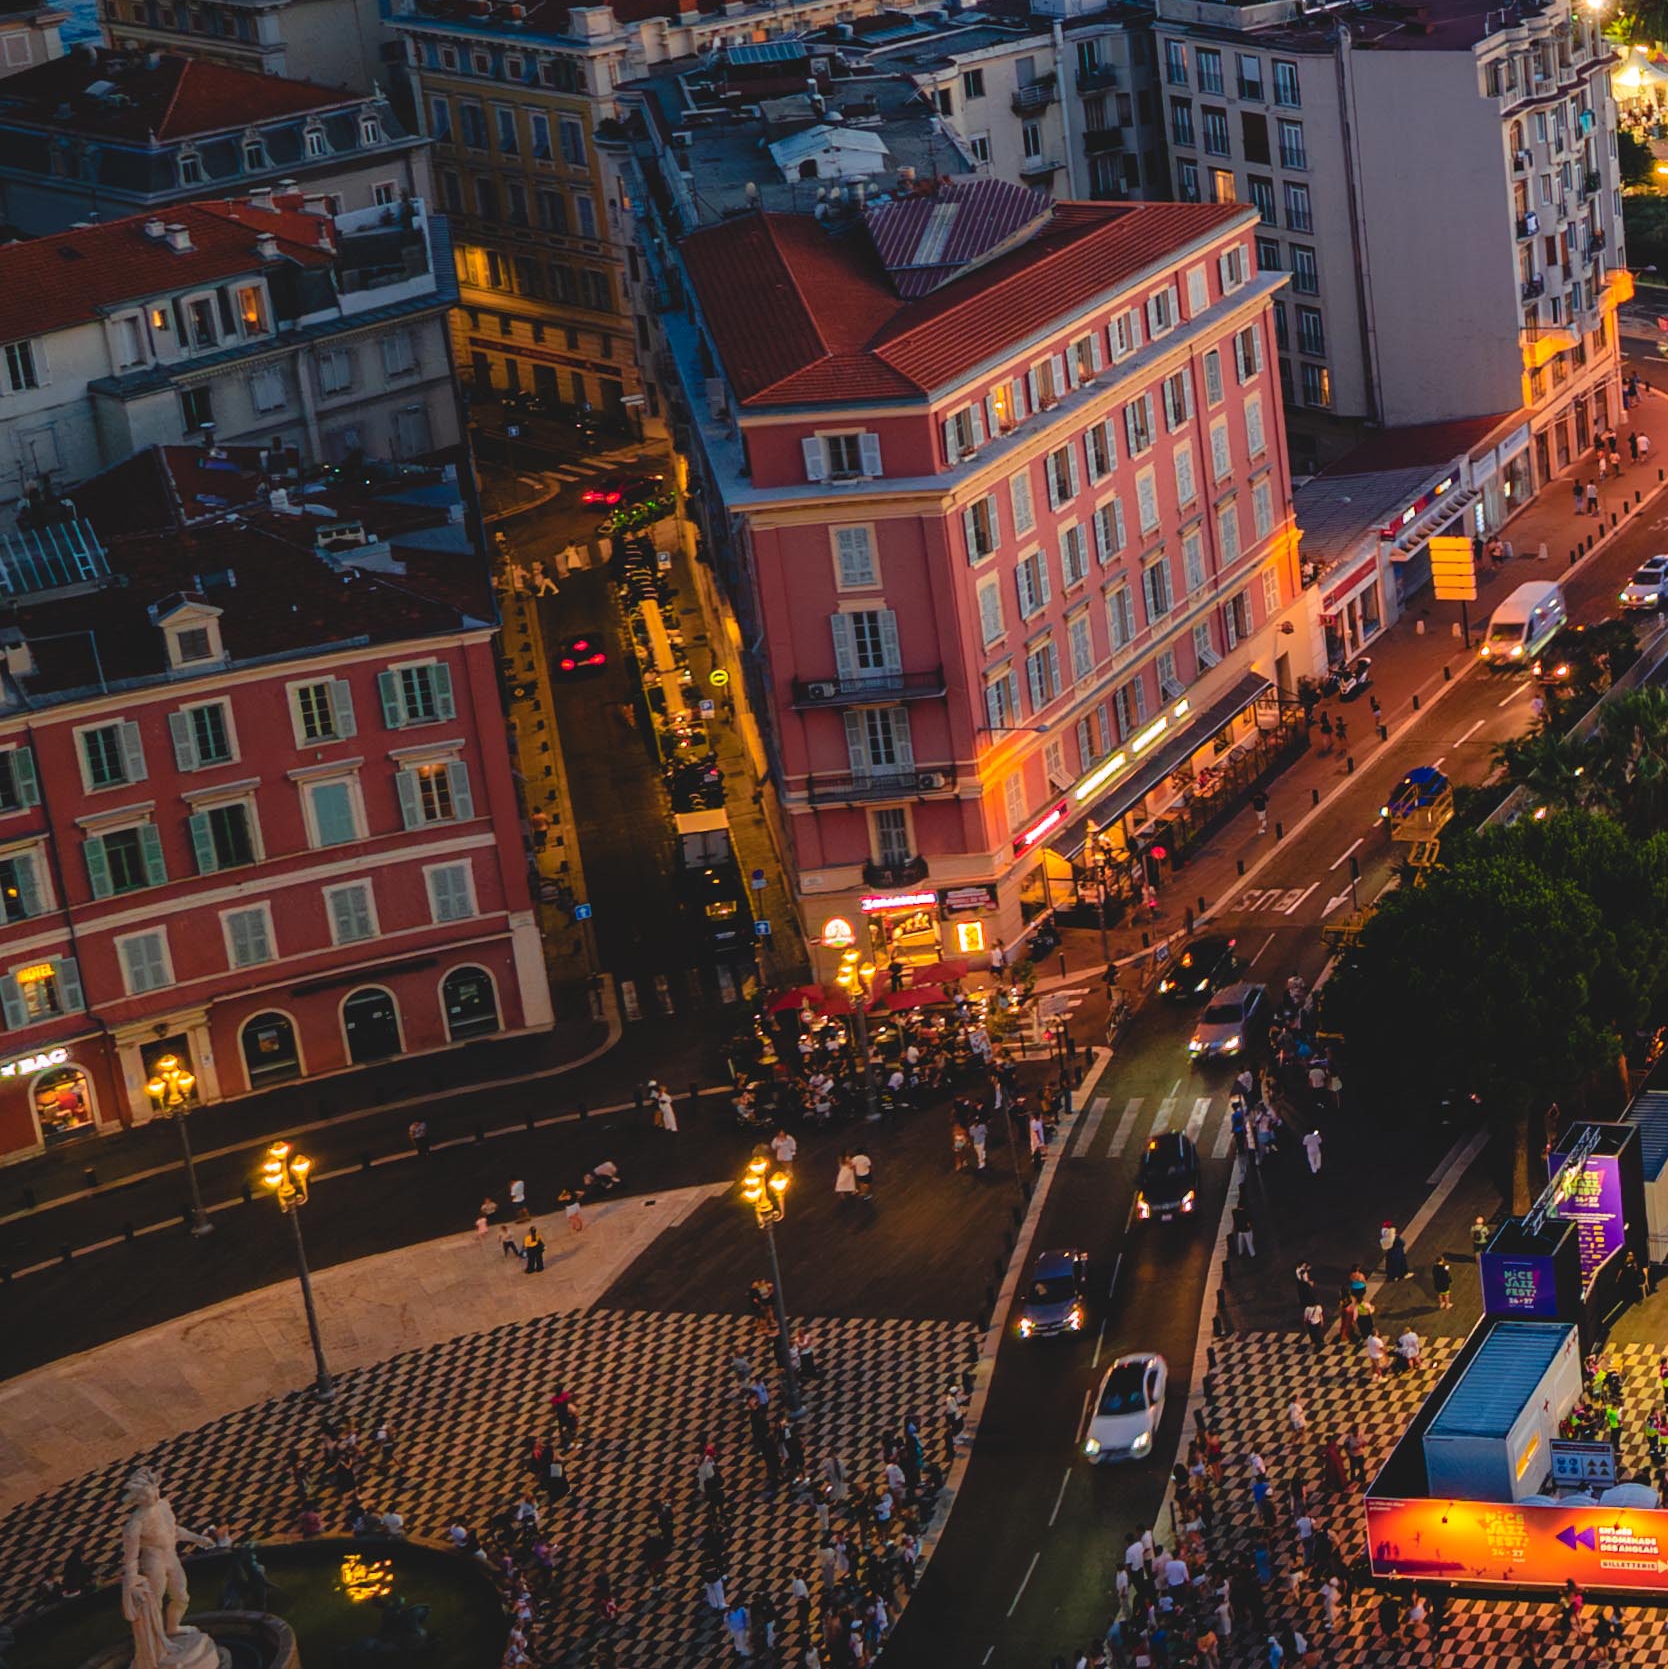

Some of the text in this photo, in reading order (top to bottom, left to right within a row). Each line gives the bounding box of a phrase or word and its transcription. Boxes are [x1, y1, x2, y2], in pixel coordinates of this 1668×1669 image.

[1578, 1171, 1599, 1180] iCE
[1505, 1277, 1535, 1288] JAZZ
[1486, 1521, 1527, 1535] JAZZ
[1600, 1536, 1656, 1545] PROMENADE
[1601, 1544, 1659, 1554] DES ANGLAIS
